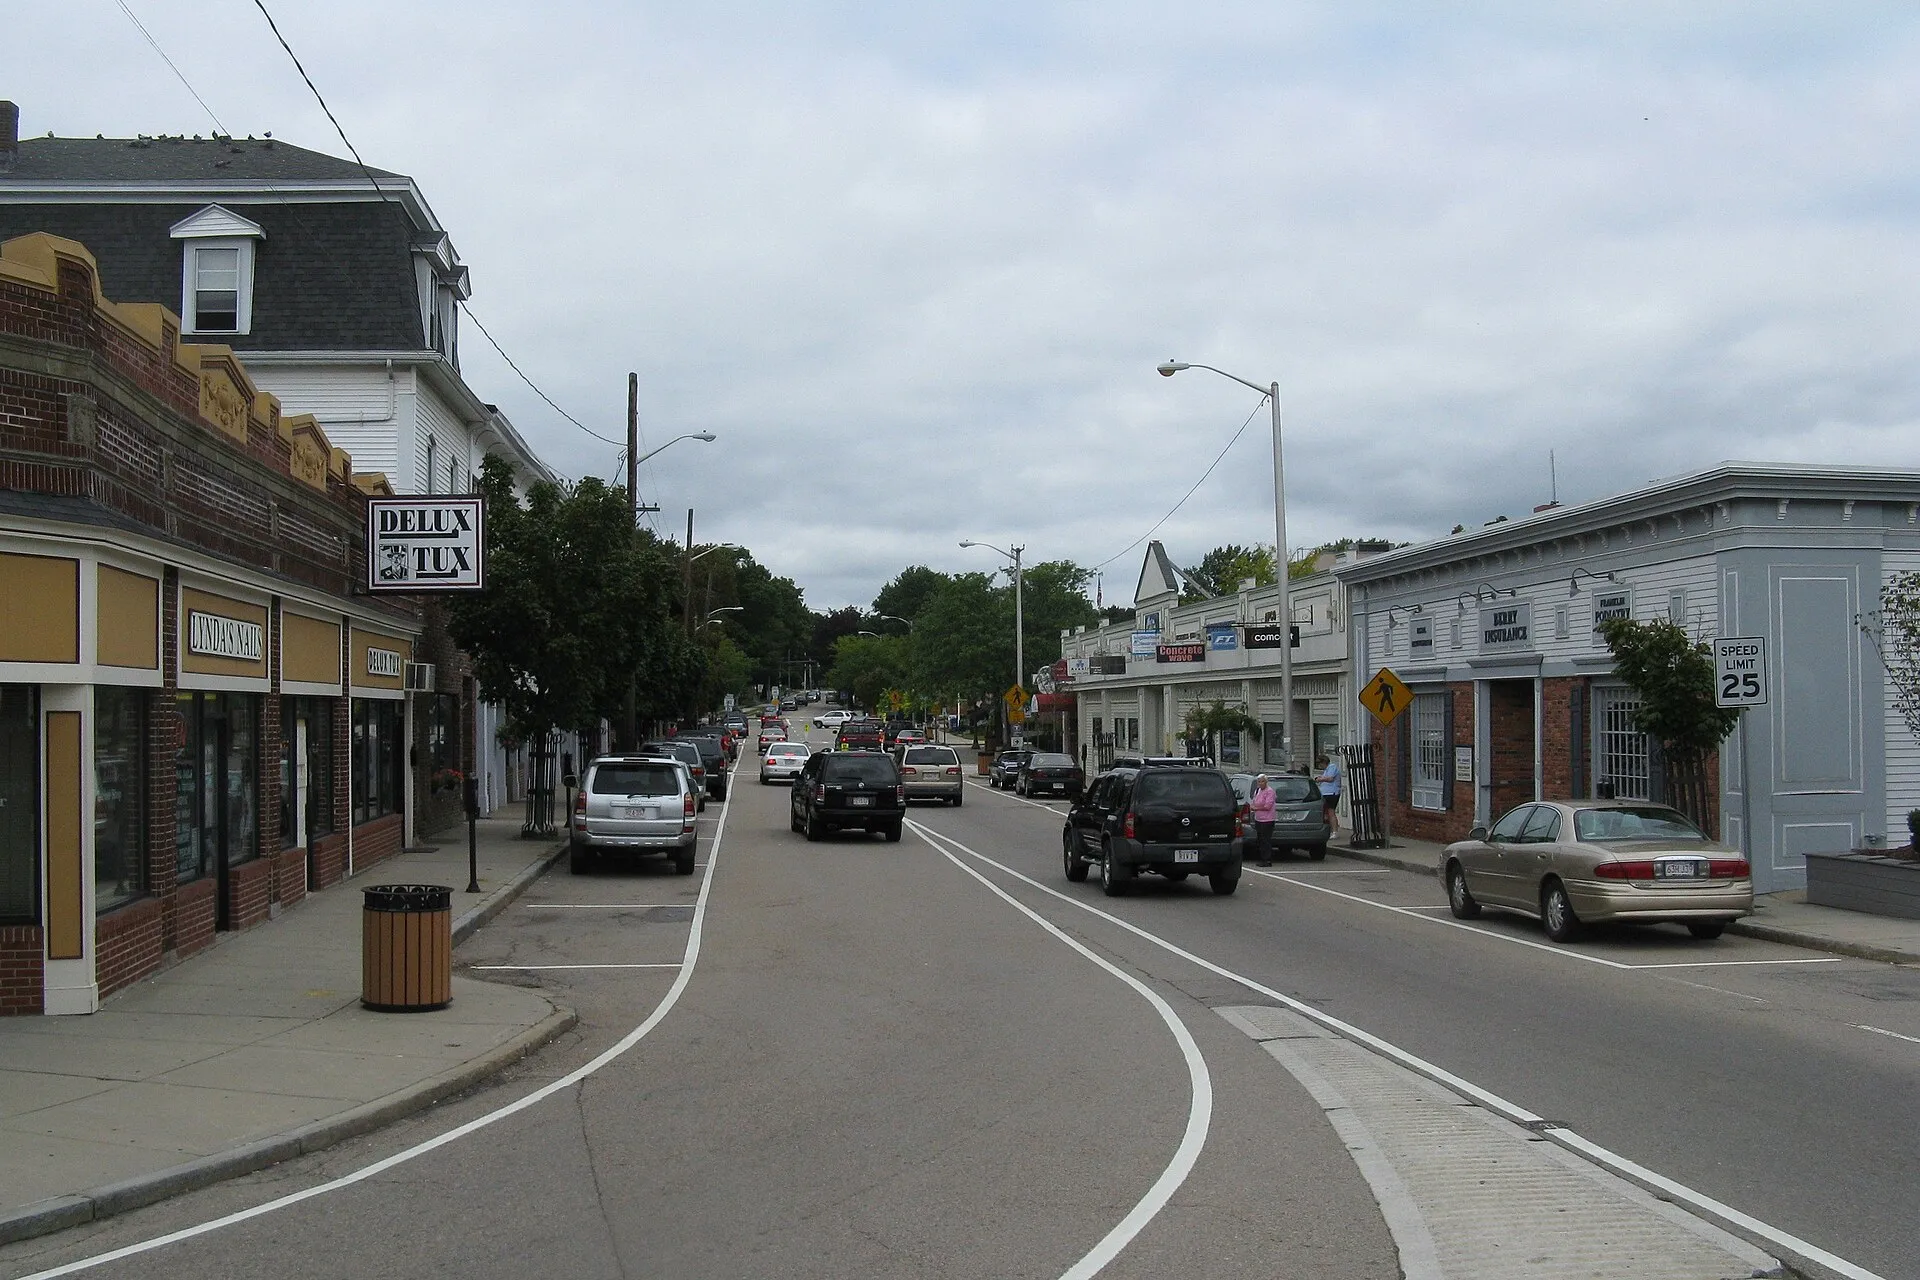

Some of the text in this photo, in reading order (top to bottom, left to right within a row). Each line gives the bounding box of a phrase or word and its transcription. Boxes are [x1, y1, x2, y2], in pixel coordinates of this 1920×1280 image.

[379, 509, 472, 533] DELUX
[413, 547, 471, 573] TUX
[192, 615, 262, 658] LYNDA'S NAILS
[1254, 632, 1294, 642] comct
[1484, 626, 1527, 644] INSURANCE
[1160, 645, 1203, 655] Concrete
[1721, 645, 1759, 656] SPEED
[1726, 659, 1755, 669] LIMIT
[1722, 673, 1760, 698] 25
